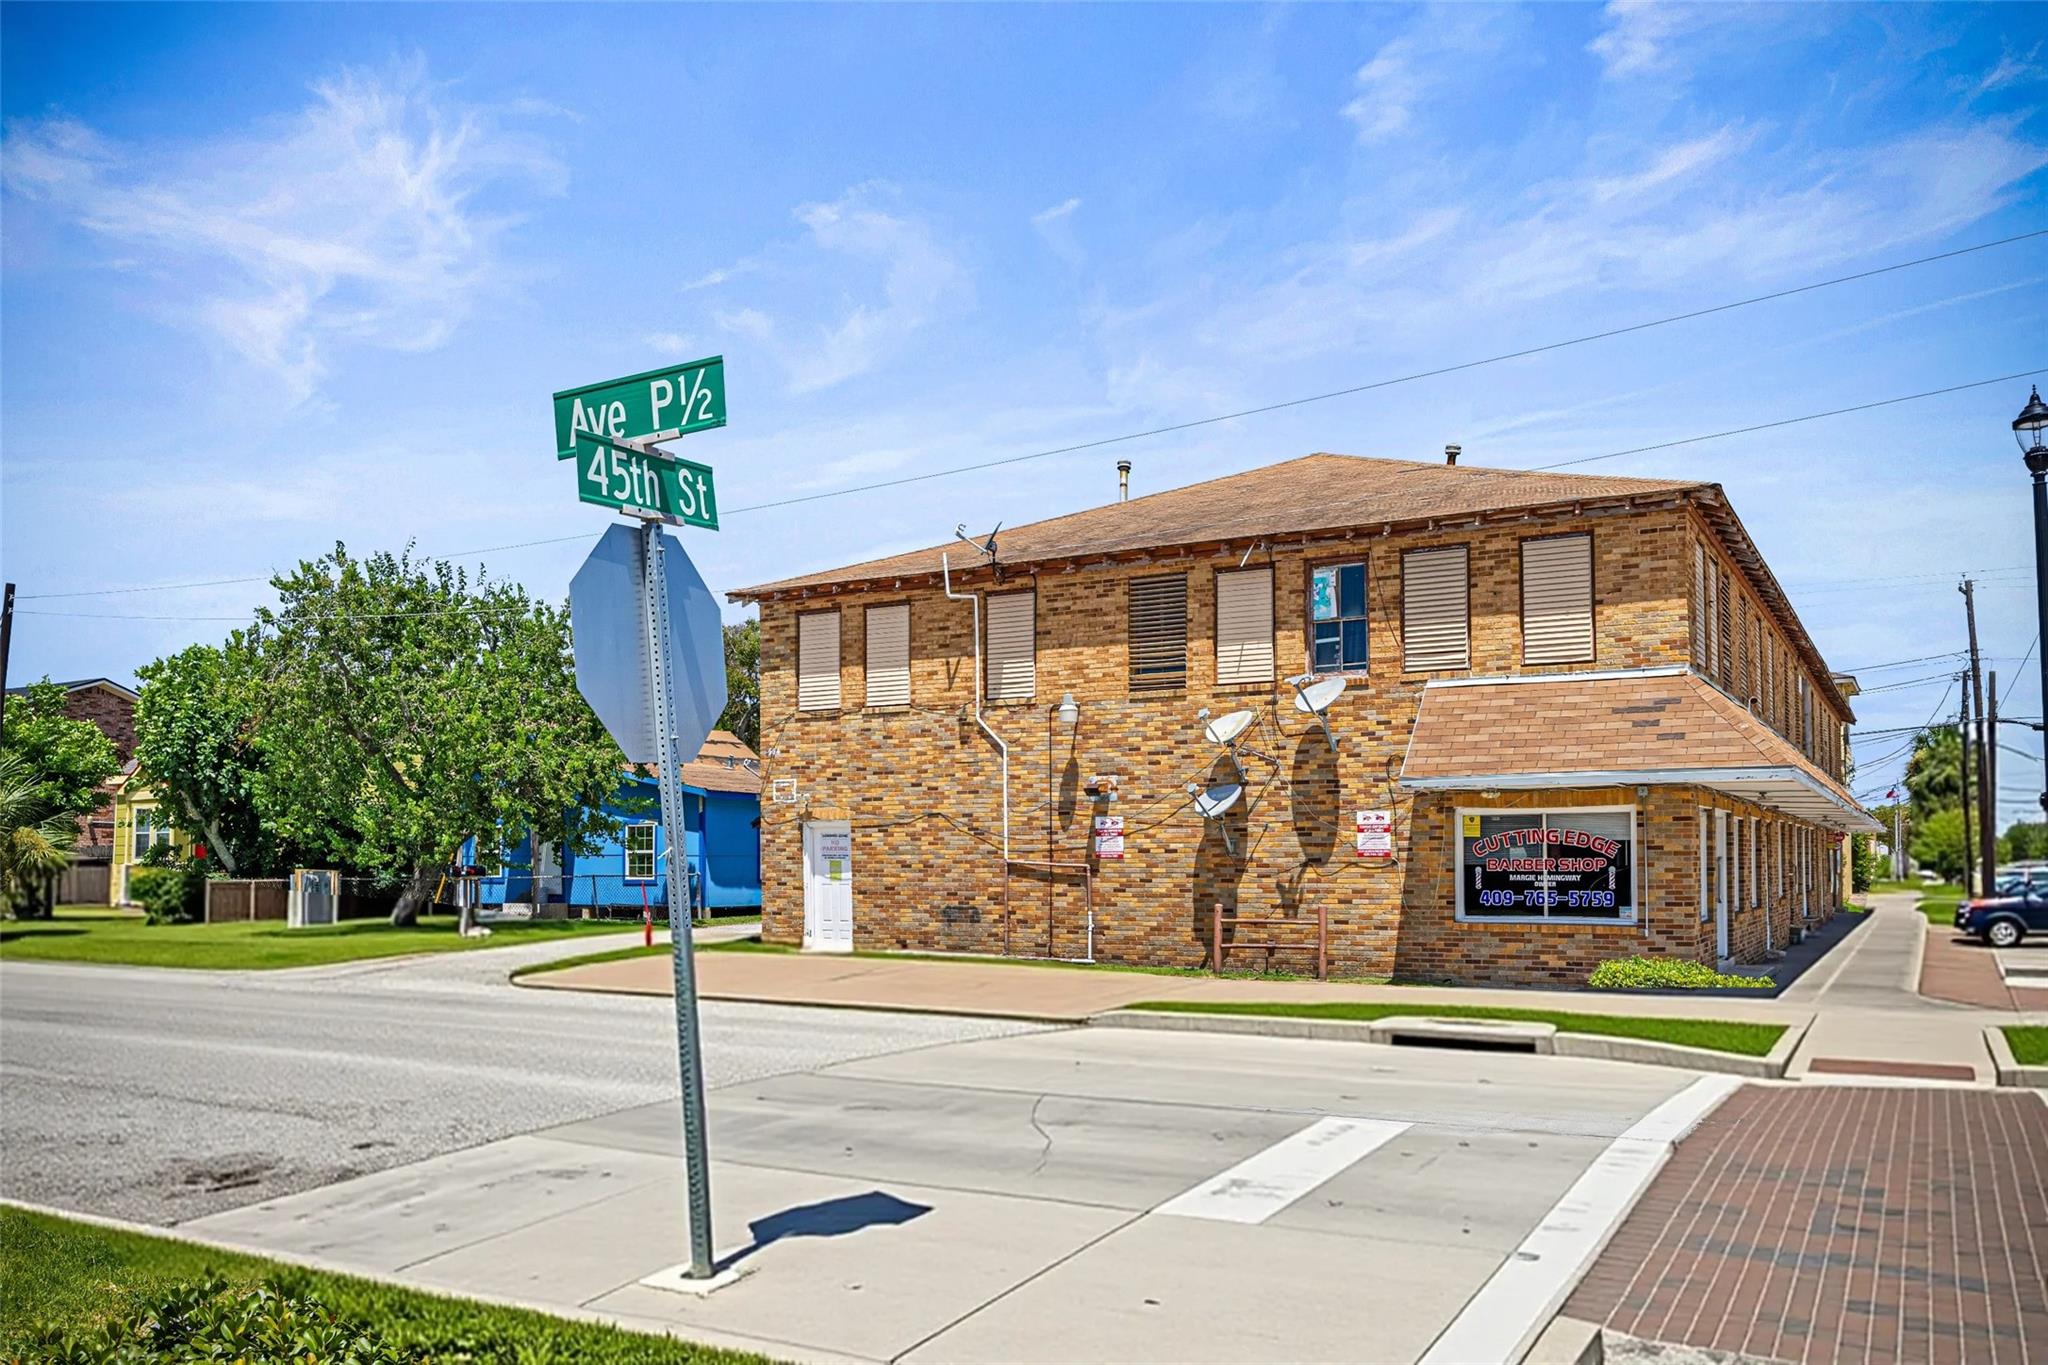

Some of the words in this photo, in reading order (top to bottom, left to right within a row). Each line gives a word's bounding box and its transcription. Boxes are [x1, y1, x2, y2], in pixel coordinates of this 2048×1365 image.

[569, 398, 627, 448] Ave
[587, 446, 660, 508] 45th
[678, 468, 710, 520] St
[1472, 827, 1560, 857] CUTTING
[1563, 829, 1622, 859] EDGE
[1487, 858, 1556, 871] BARBER
[1559, 858, 1608, 871] SHOP
[1480, 890, 1615, 907] 409-765-5759
